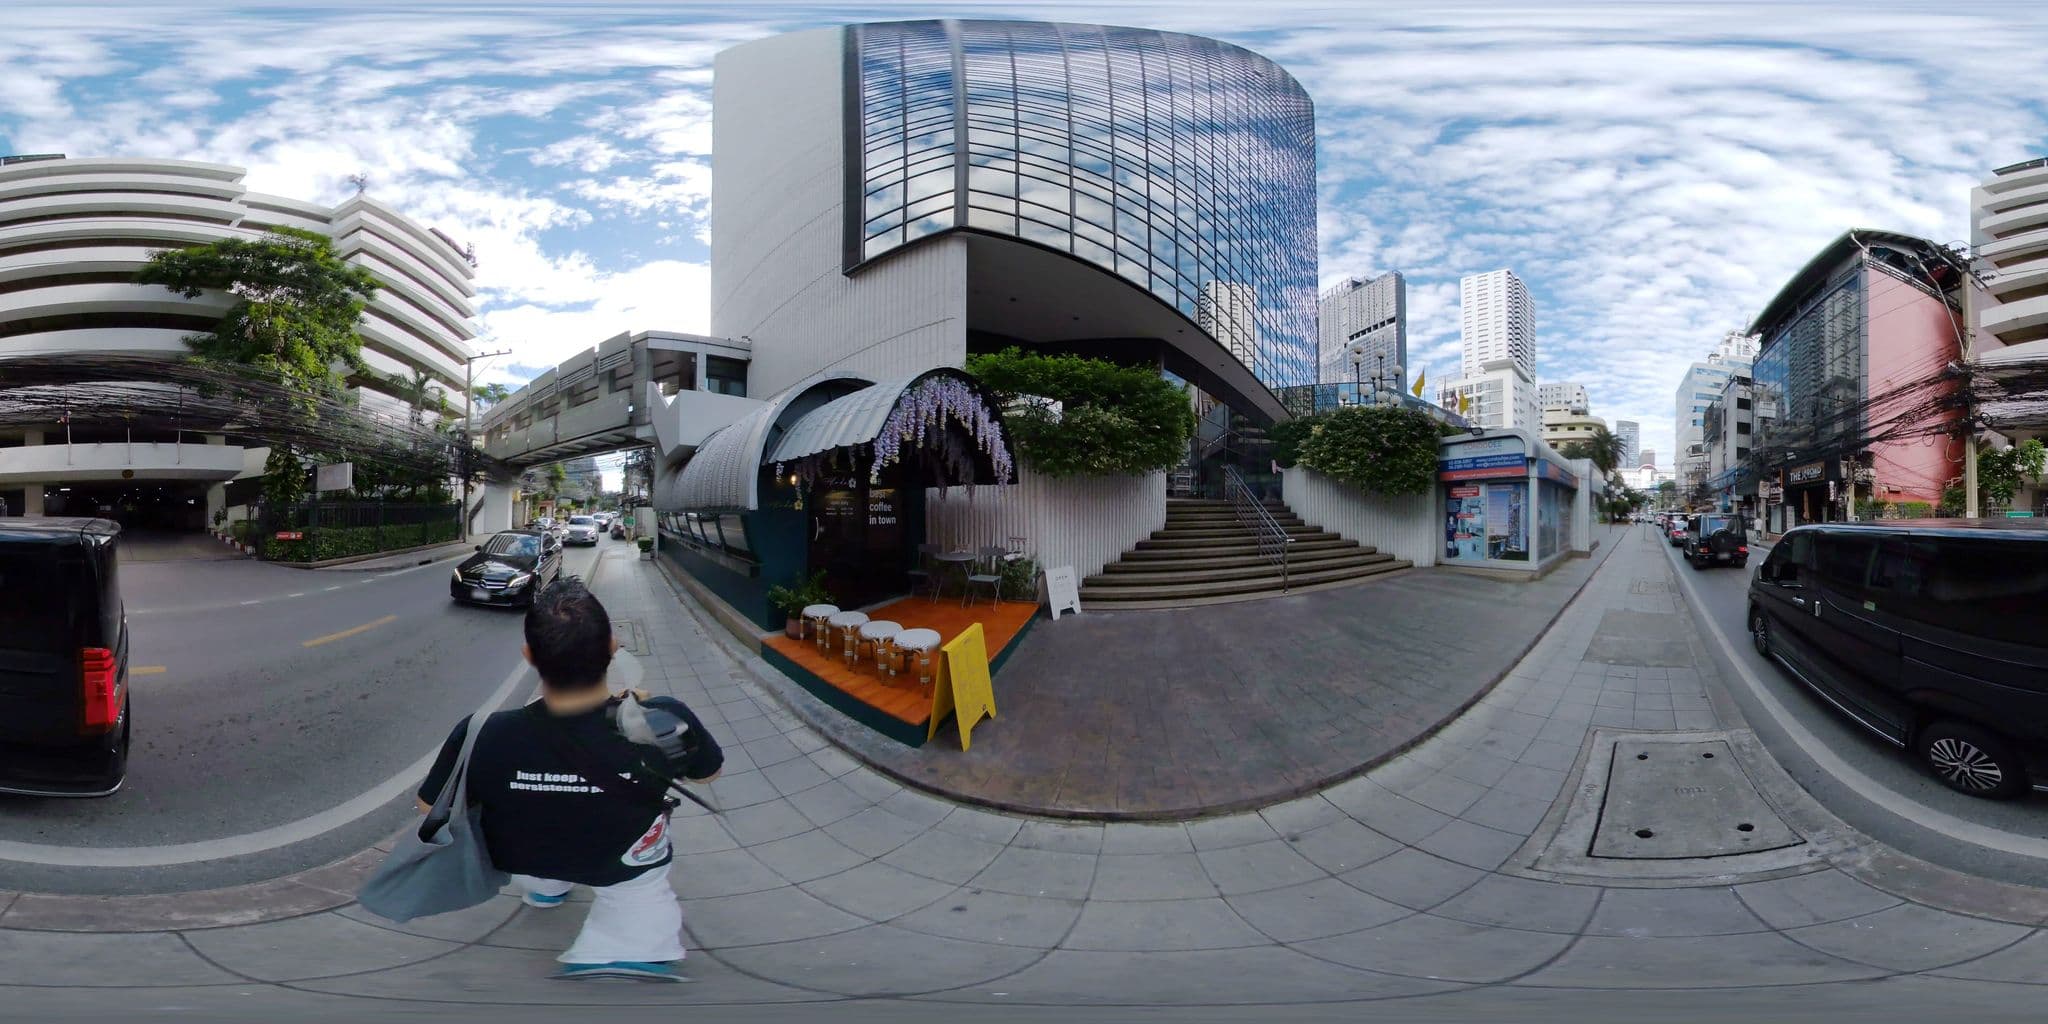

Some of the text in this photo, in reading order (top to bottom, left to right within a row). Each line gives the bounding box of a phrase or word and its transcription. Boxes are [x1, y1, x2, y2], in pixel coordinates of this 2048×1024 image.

[869, 502, 893, 512] coffee
[869, 514, 897, 525] in town
[544, 773, 578, 783] keep
